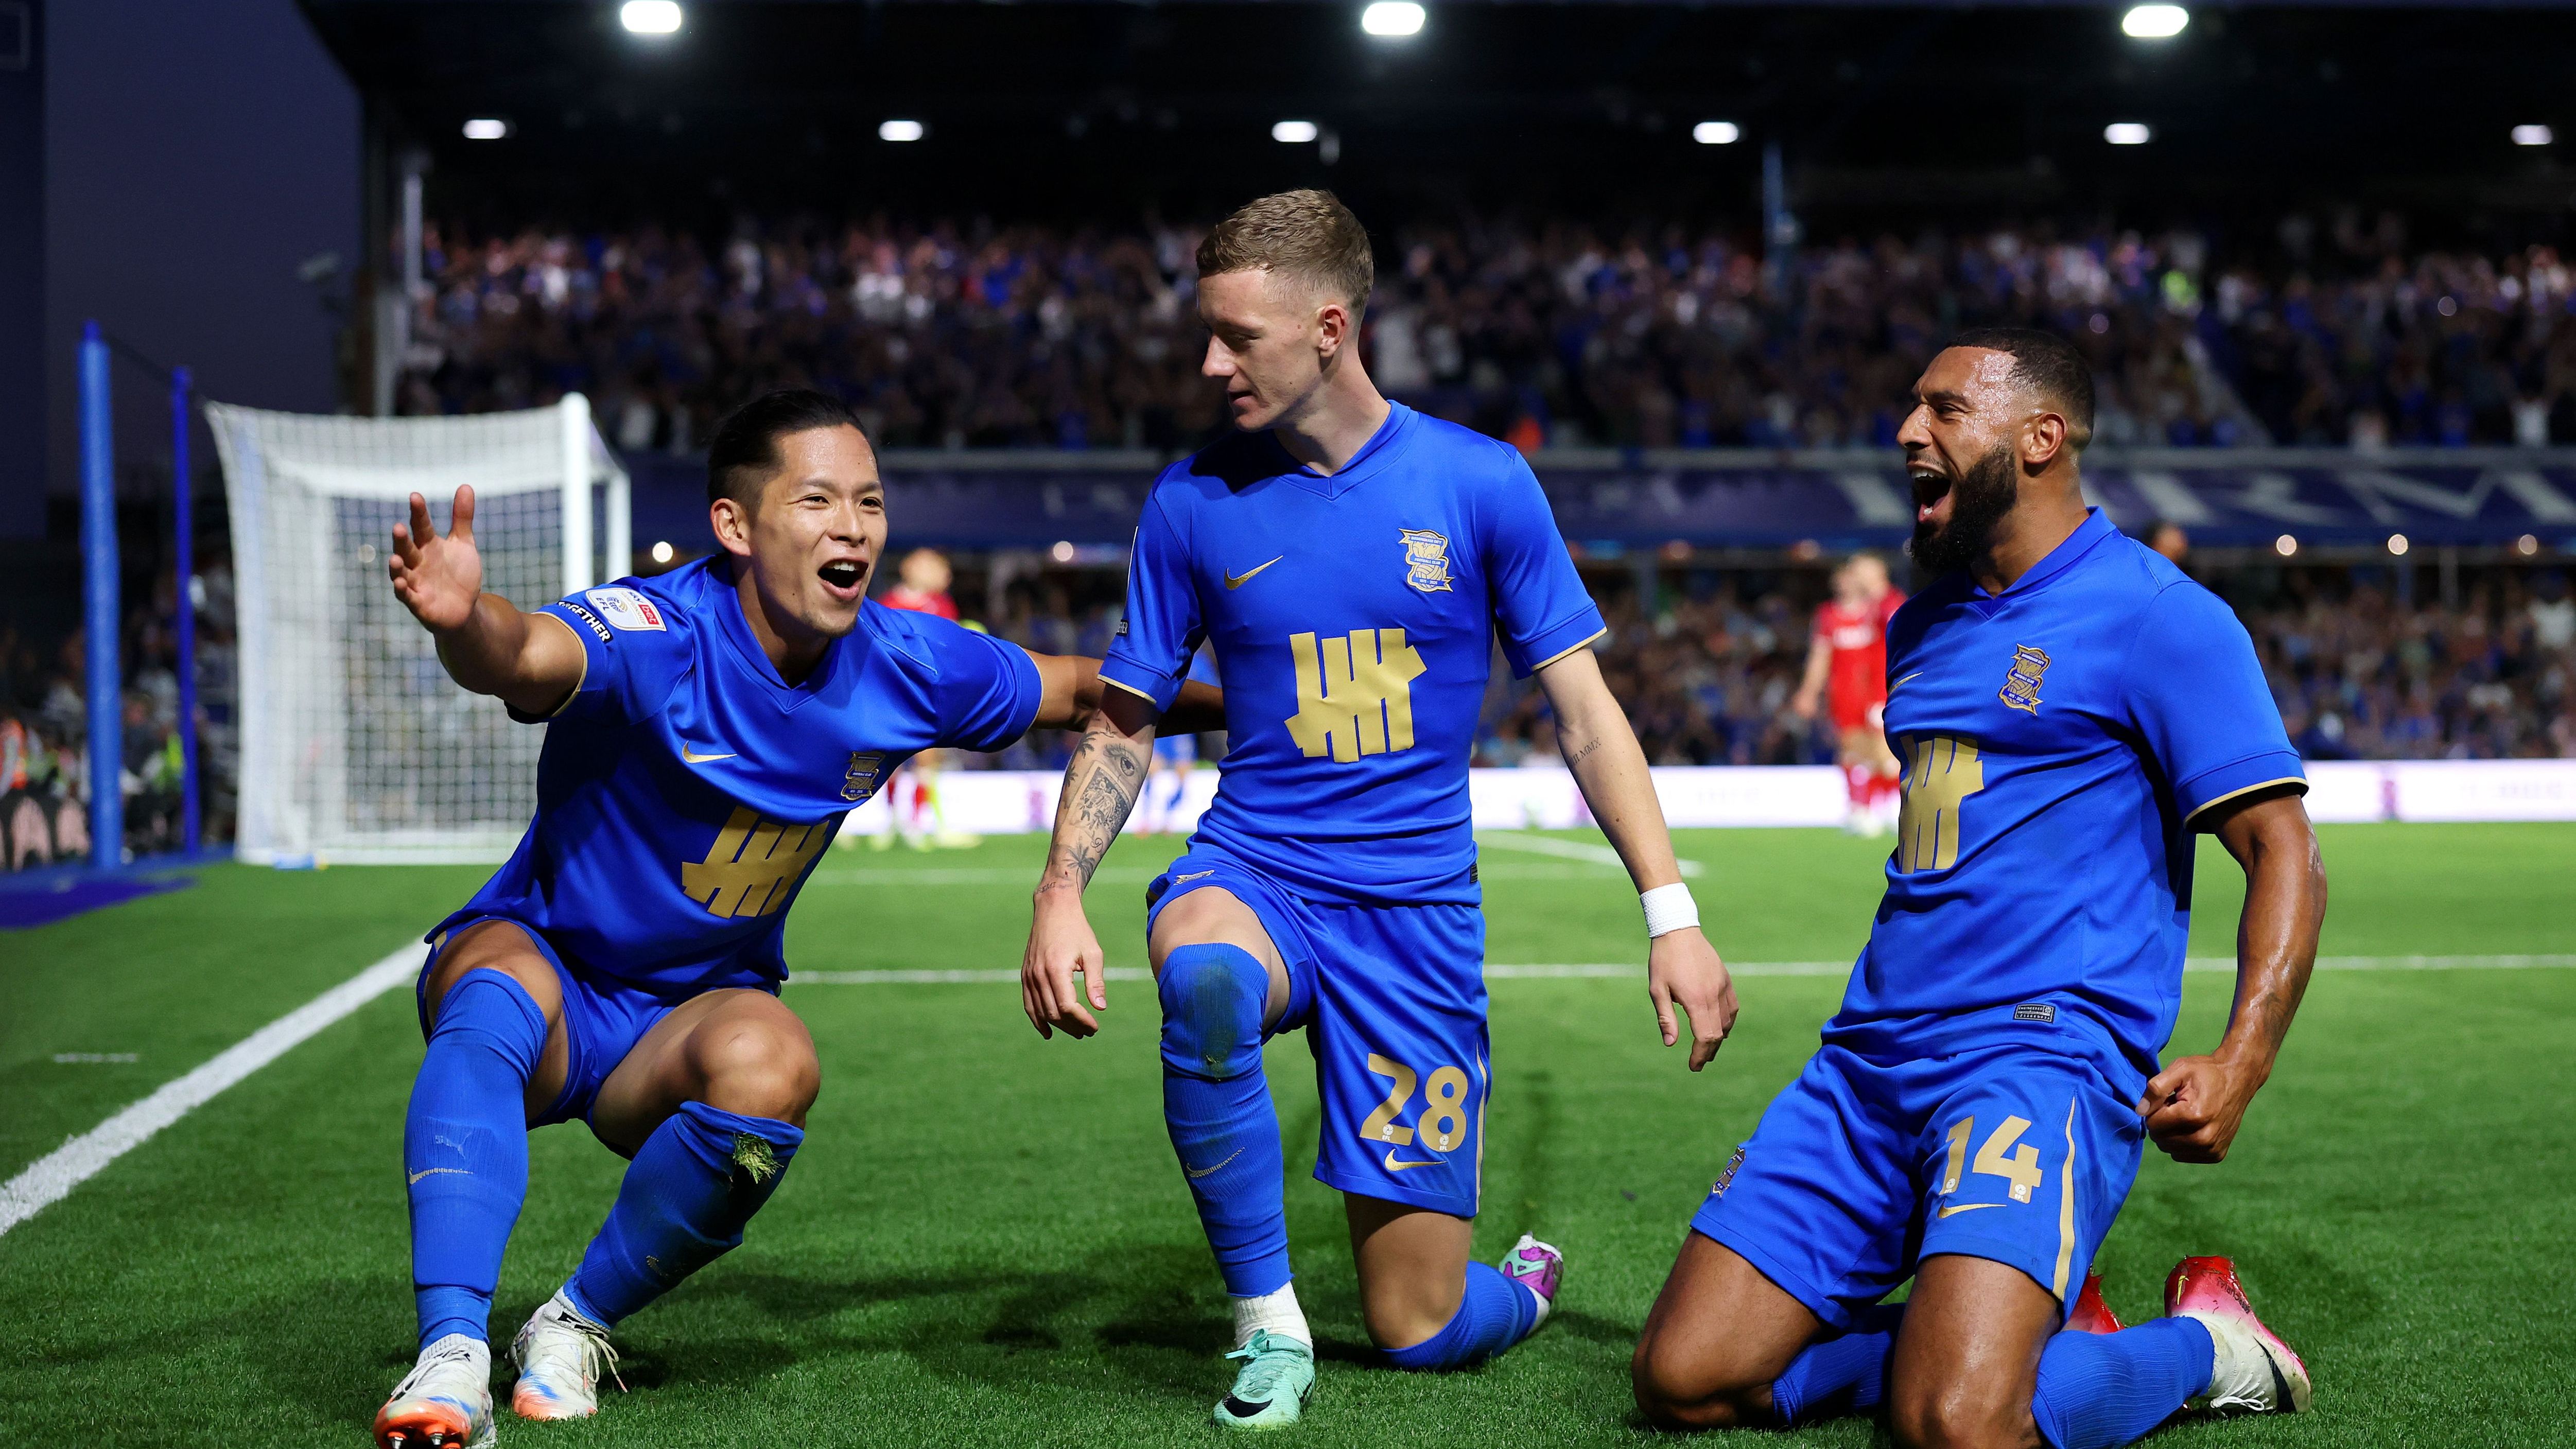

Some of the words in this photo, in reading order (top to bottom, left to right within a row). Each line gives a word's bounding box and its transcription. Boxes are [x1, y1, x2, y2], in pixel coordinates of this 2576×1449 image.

[595, 597, 610, 611] EFL
[641, 605, 657, 623] bet
[1359, 1052, 1468, 1153] 28
[1939, 1114, 2043, 1204] 14
